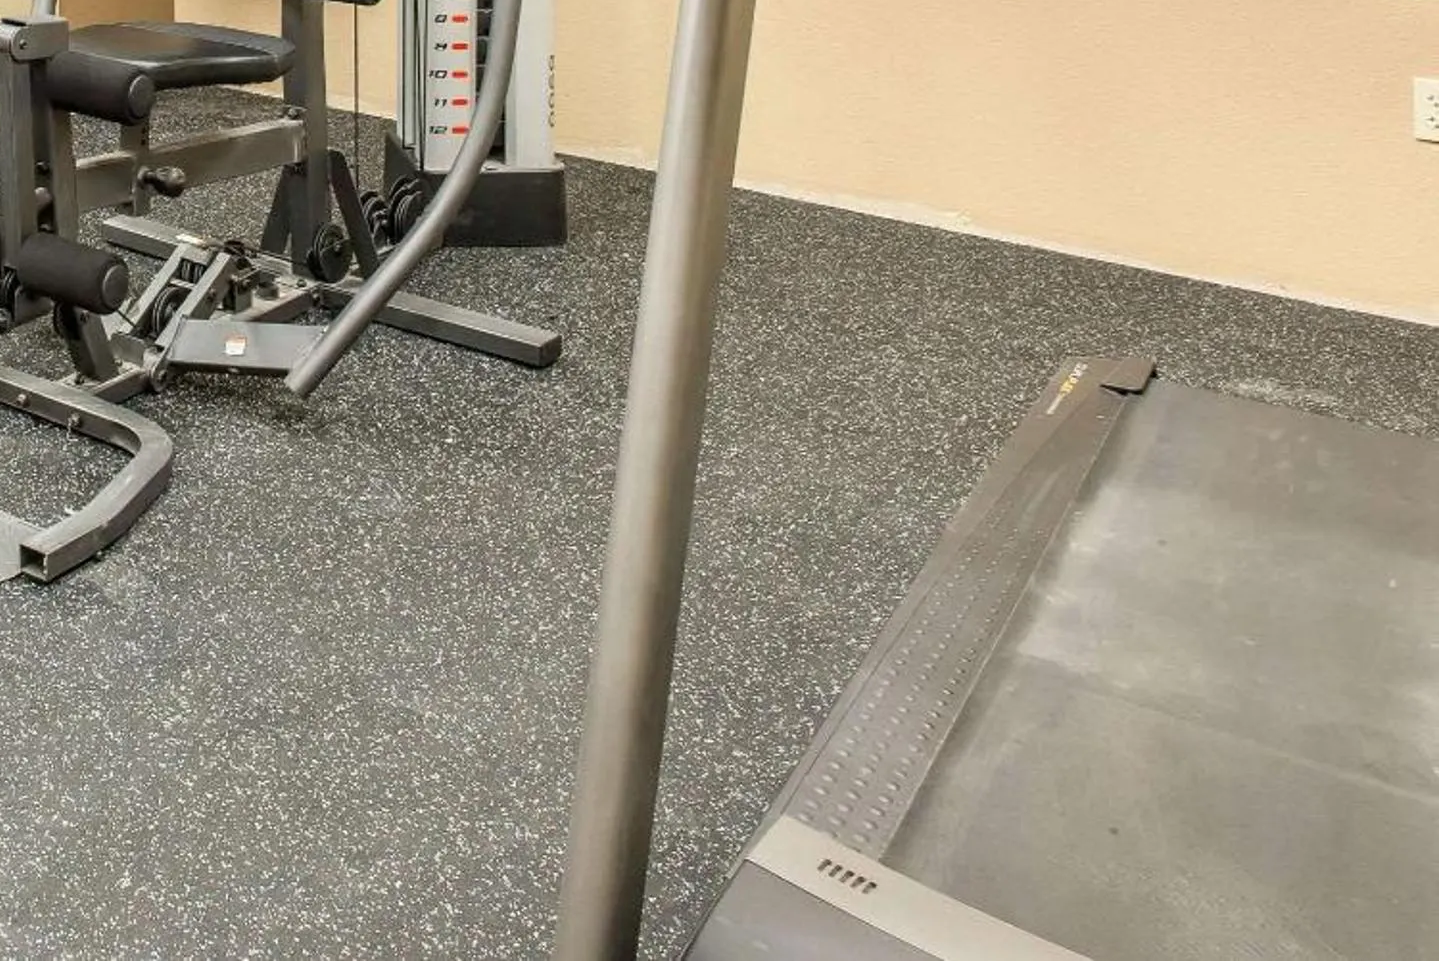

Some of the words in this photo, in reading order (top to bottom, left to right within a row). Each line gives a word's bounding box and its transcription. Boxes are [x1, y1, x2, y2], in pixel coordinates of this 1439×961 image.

[428, 70, 448, 80] 10
[434, 98, 448, 108] 11
[428, 125, 448, 135] 12
